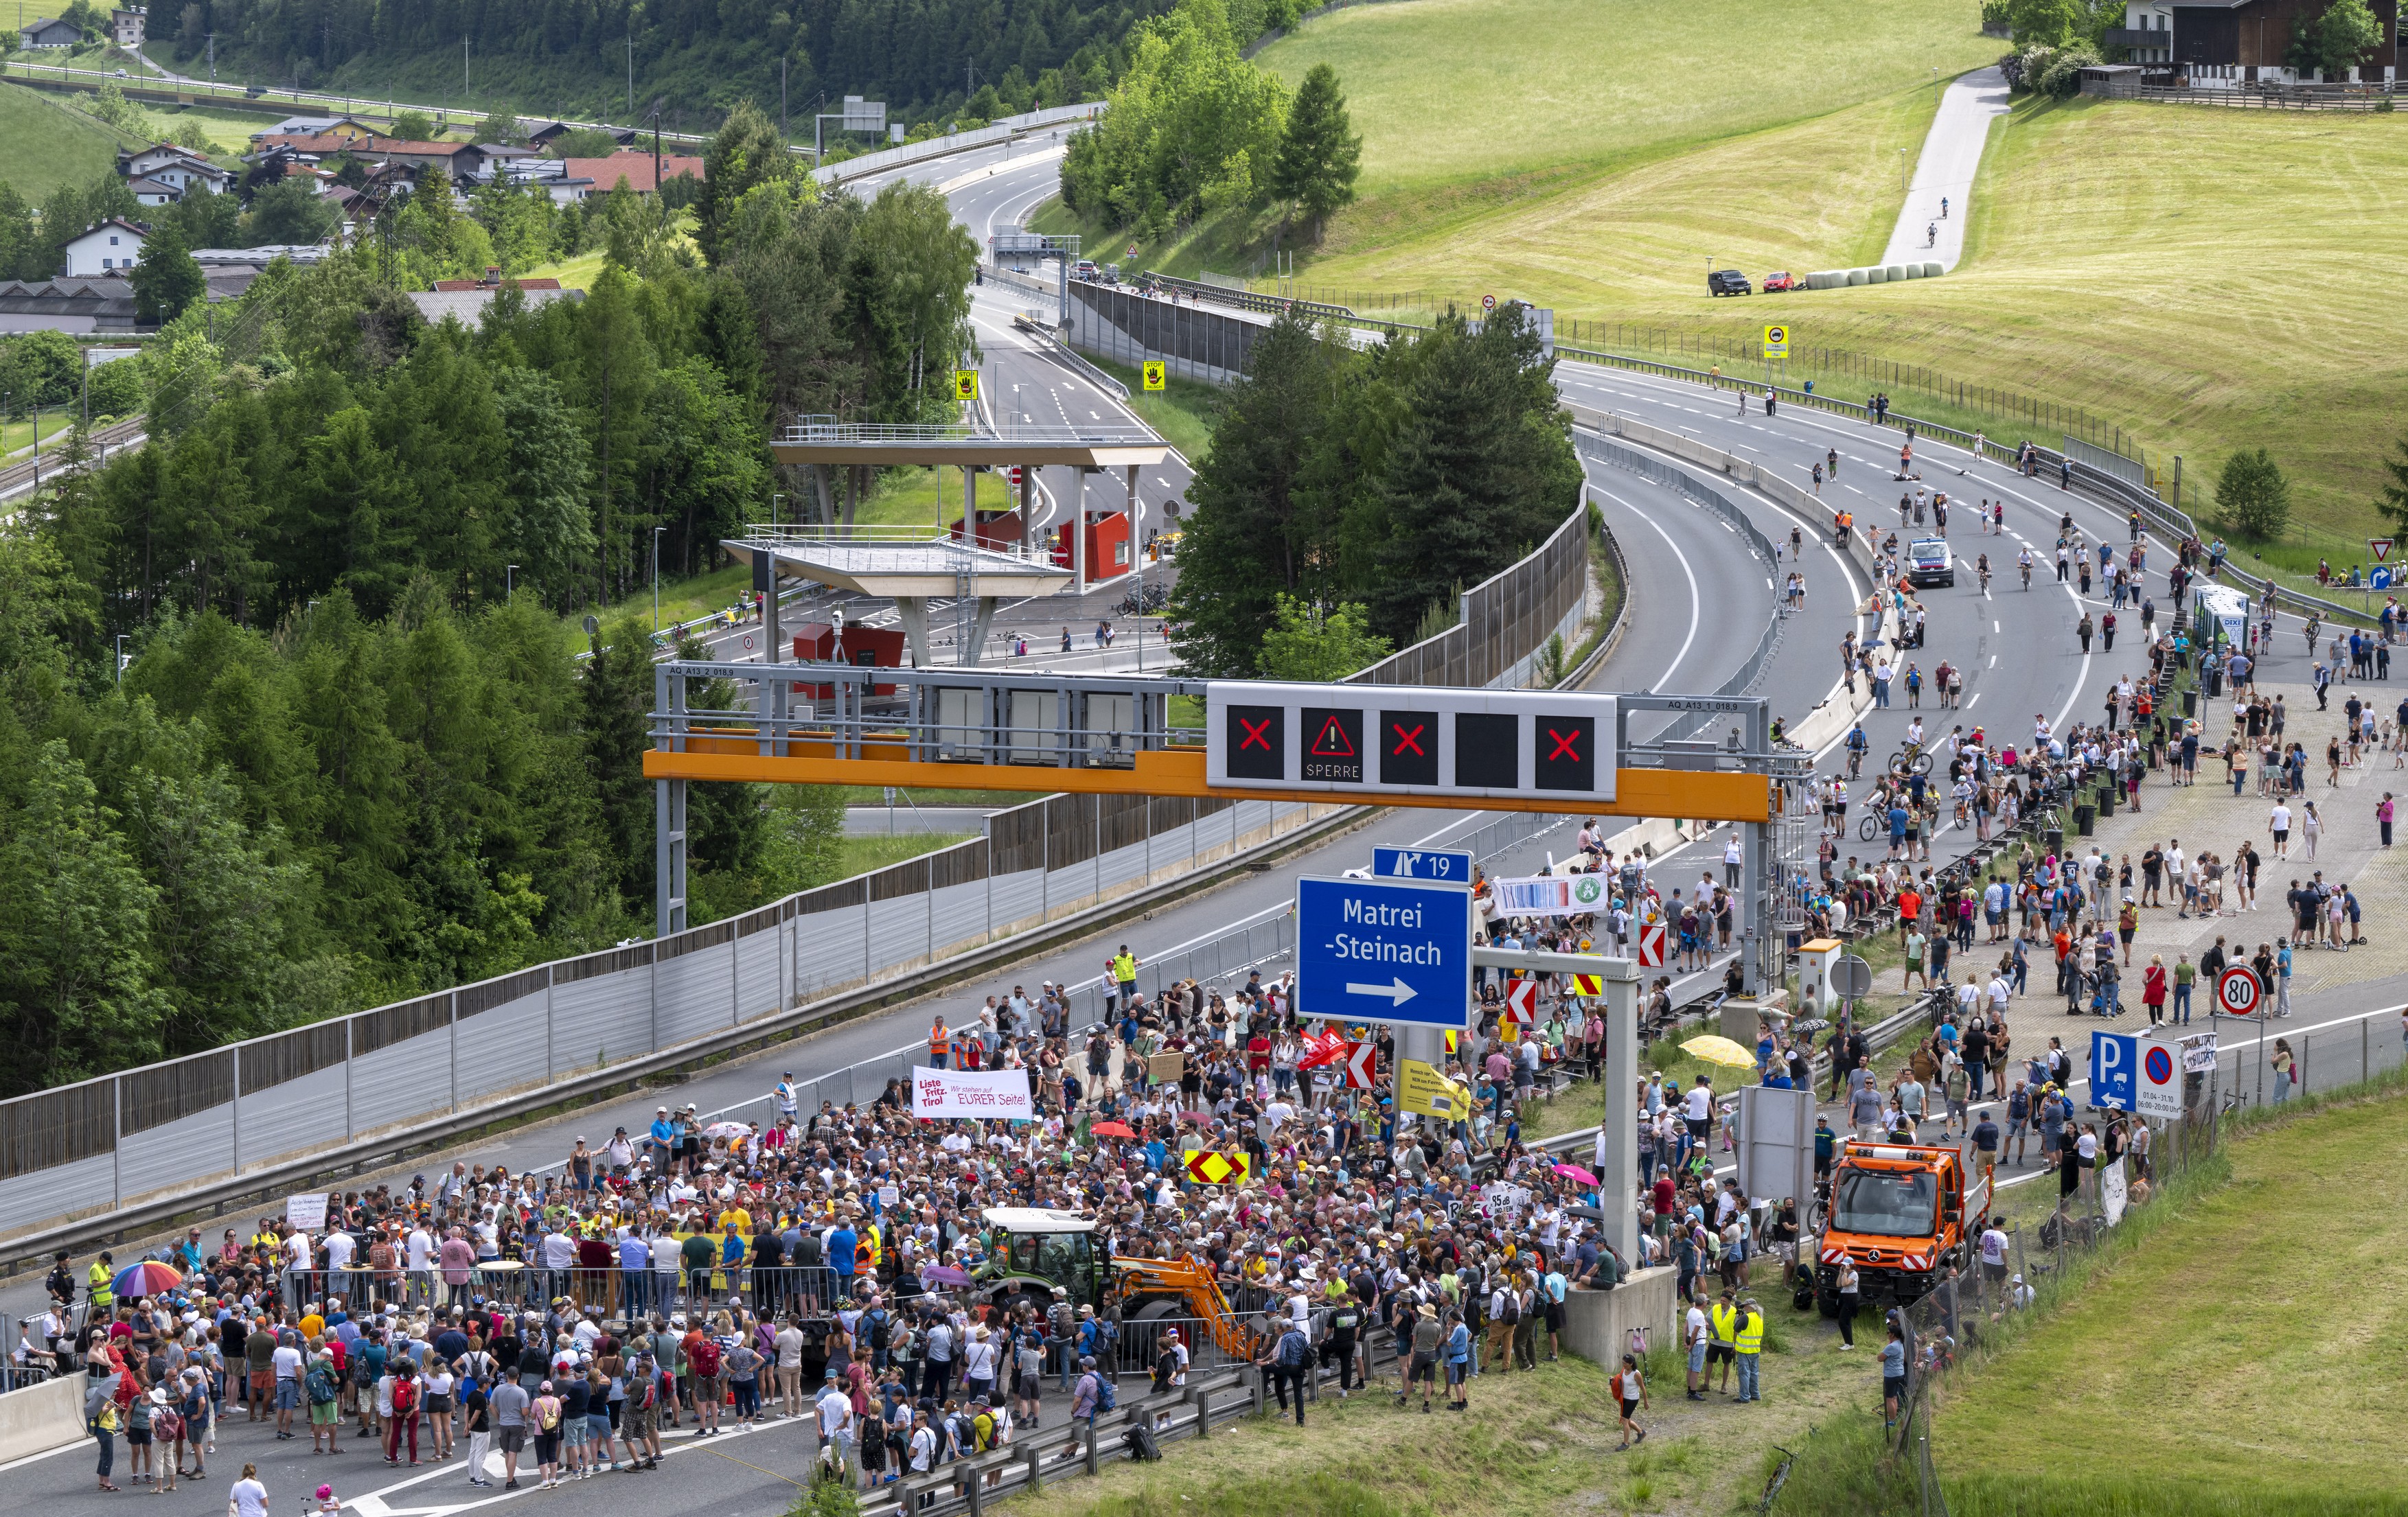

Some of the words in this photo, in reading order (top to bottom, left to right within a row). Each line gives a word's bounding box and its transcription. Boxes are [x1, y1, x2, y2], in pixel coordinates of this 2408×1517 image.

[669, 667, 734, 678] AQ_A13_2_018,9
[1668, 701, 1738, 712] AQ_A13_1_018,9
[1307, 764, 1359, 778] SPERRE
[1429, 857, 1450, 877] 19
[1344, 898, 1422, 928] Matrei
[1325, 933, 1441, 966] -Steinach
[2227, 980, 2251, 1004] 80
[2100, 1037, 2121, 1083] P
[919, 1079, 941, 1089] Liste
[925, 1087, 948, 1098] Fritz.
[2143, 1091, 2157, 1100] 01.04
[2161, 1094, 2174, 1103] 31.10
[922, 1096, 943, 1107] Tirol
[958, 1093, 996, 1105] EURER
[998, 1093, 1026, 1106] Seite!
[2170, 1105, 2179, 1113] Uhr
[1492, 1194, 1502, 1207] 85
[1502, 1196, 1510, 1206] dB
